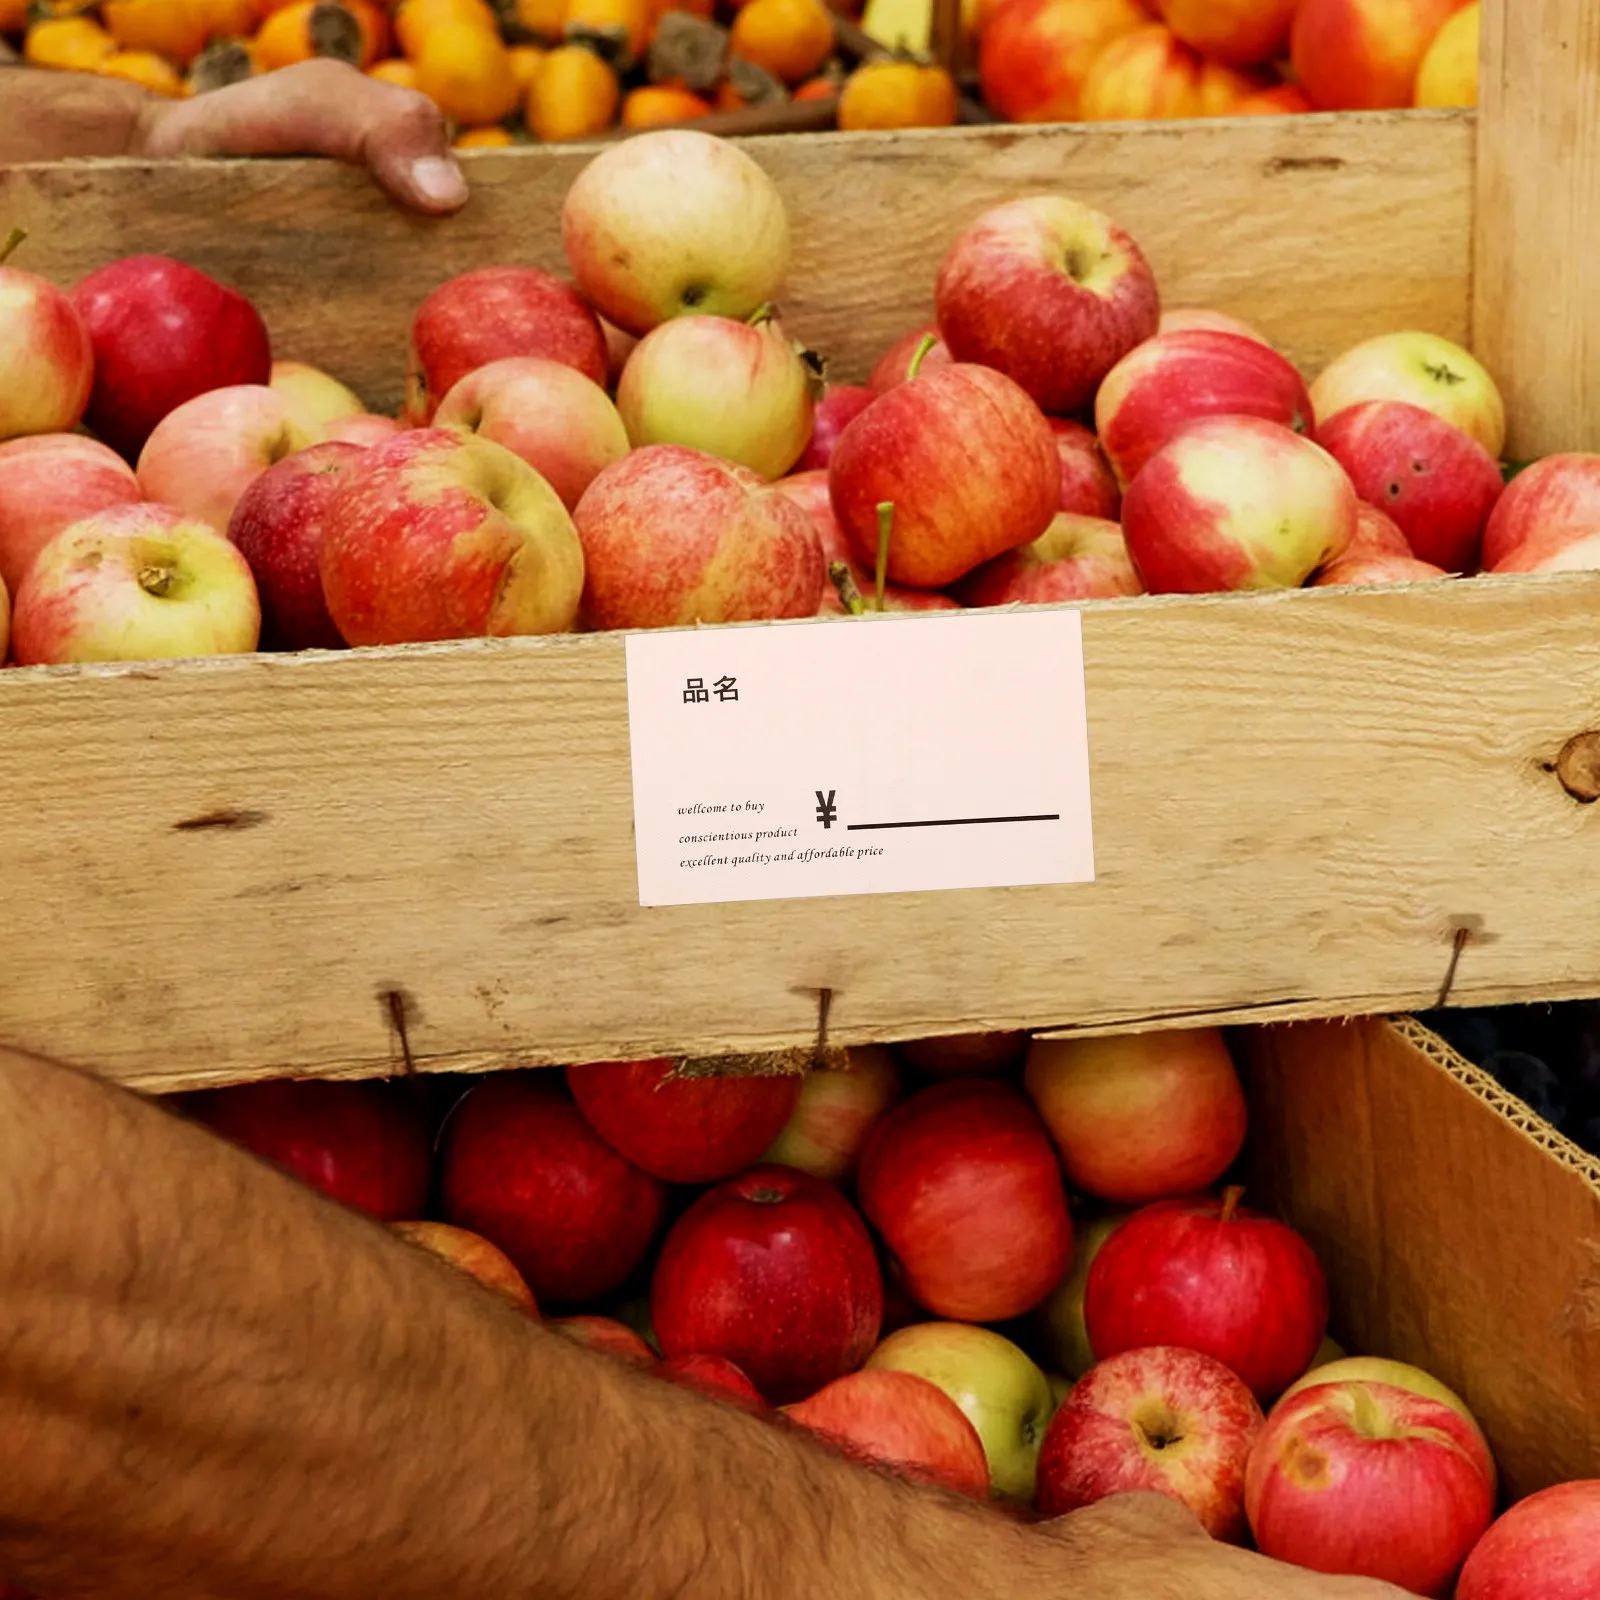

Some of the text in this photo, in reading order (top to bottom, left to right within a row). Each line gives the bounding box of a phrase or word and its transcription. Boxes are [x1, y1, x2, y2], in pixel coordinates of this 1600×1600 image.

[682, 676, 739, 704] 品名
[677, 800, 765, 816] wellcome to buy
[815, 790, 838, 829] ¥
[678, 827, 798, 844] conscientious product
[680, 845, 884, 868] excellent quality and affordable price
